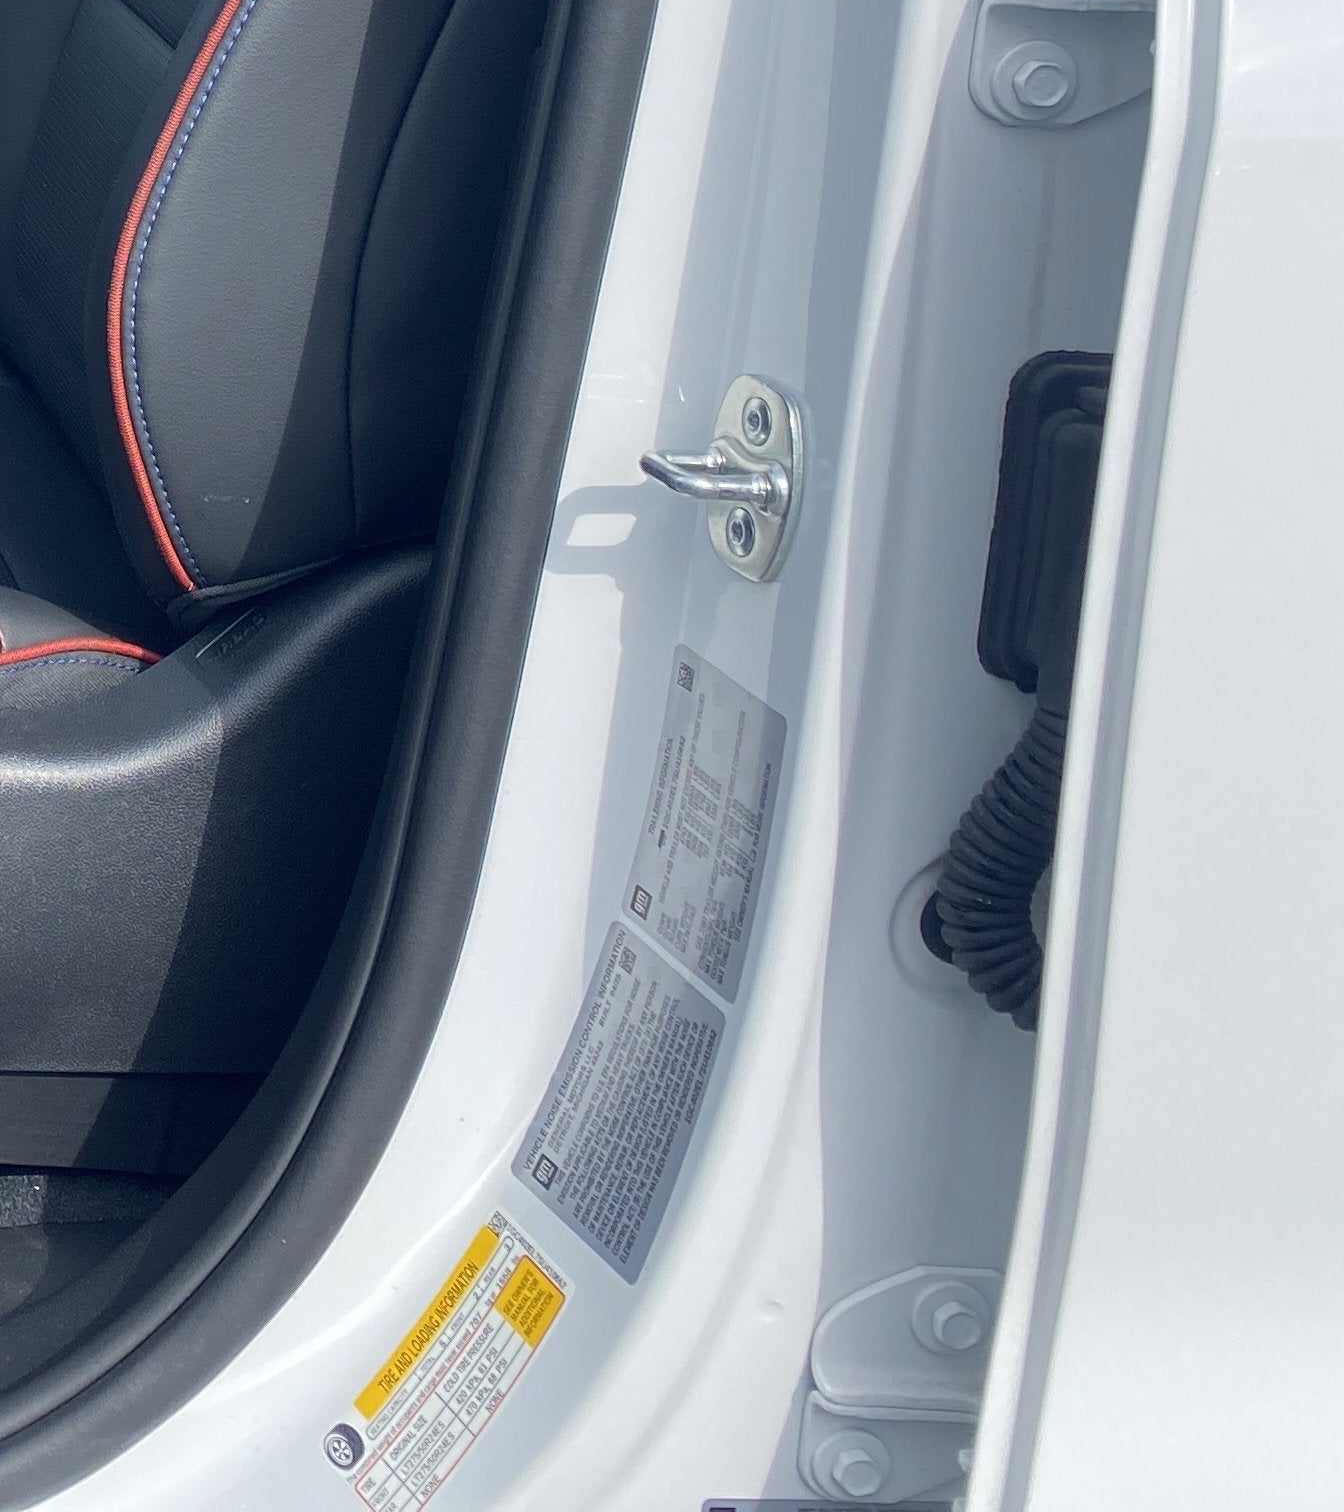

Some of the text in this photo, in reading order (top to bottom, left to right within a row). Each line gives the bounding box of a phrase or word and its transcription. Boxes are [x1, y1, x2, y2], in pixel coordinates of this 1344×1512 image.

[523, 928, 625, 1172] VEHICLE NOISE EMISSION CONTROL INFORMATION
[472, 1291, 480, 1300] 2
[510, 1278, 539, 1322] MANUAL FOR
[517, 1288, 545, 1327] ADDITIONAL
[523, 1291, 554, 1338] INFORMATION
[377, 1259, 478, 1394] TIRE AND LOADING INFORMATION
[442, 1371, 460, 1393] COLD
[456, 1356, 470, 1373] TIRE
[466, 1322, 494, 1360] PRESSURE
[455, 1389, 467, 1405] 420
[485, 1346, 498, 1362] PSI
[464, 1400, 477, 1416] 470
[494, 1357, 508, 1373] PSI
[485, 1388, 504, 1413] NONE
[388, 1414, 427, 1461] ORIGINAL SIZE
[360, 1477, 376, 1494] TIRE
[420, 1474, 440, 1498] NONE
